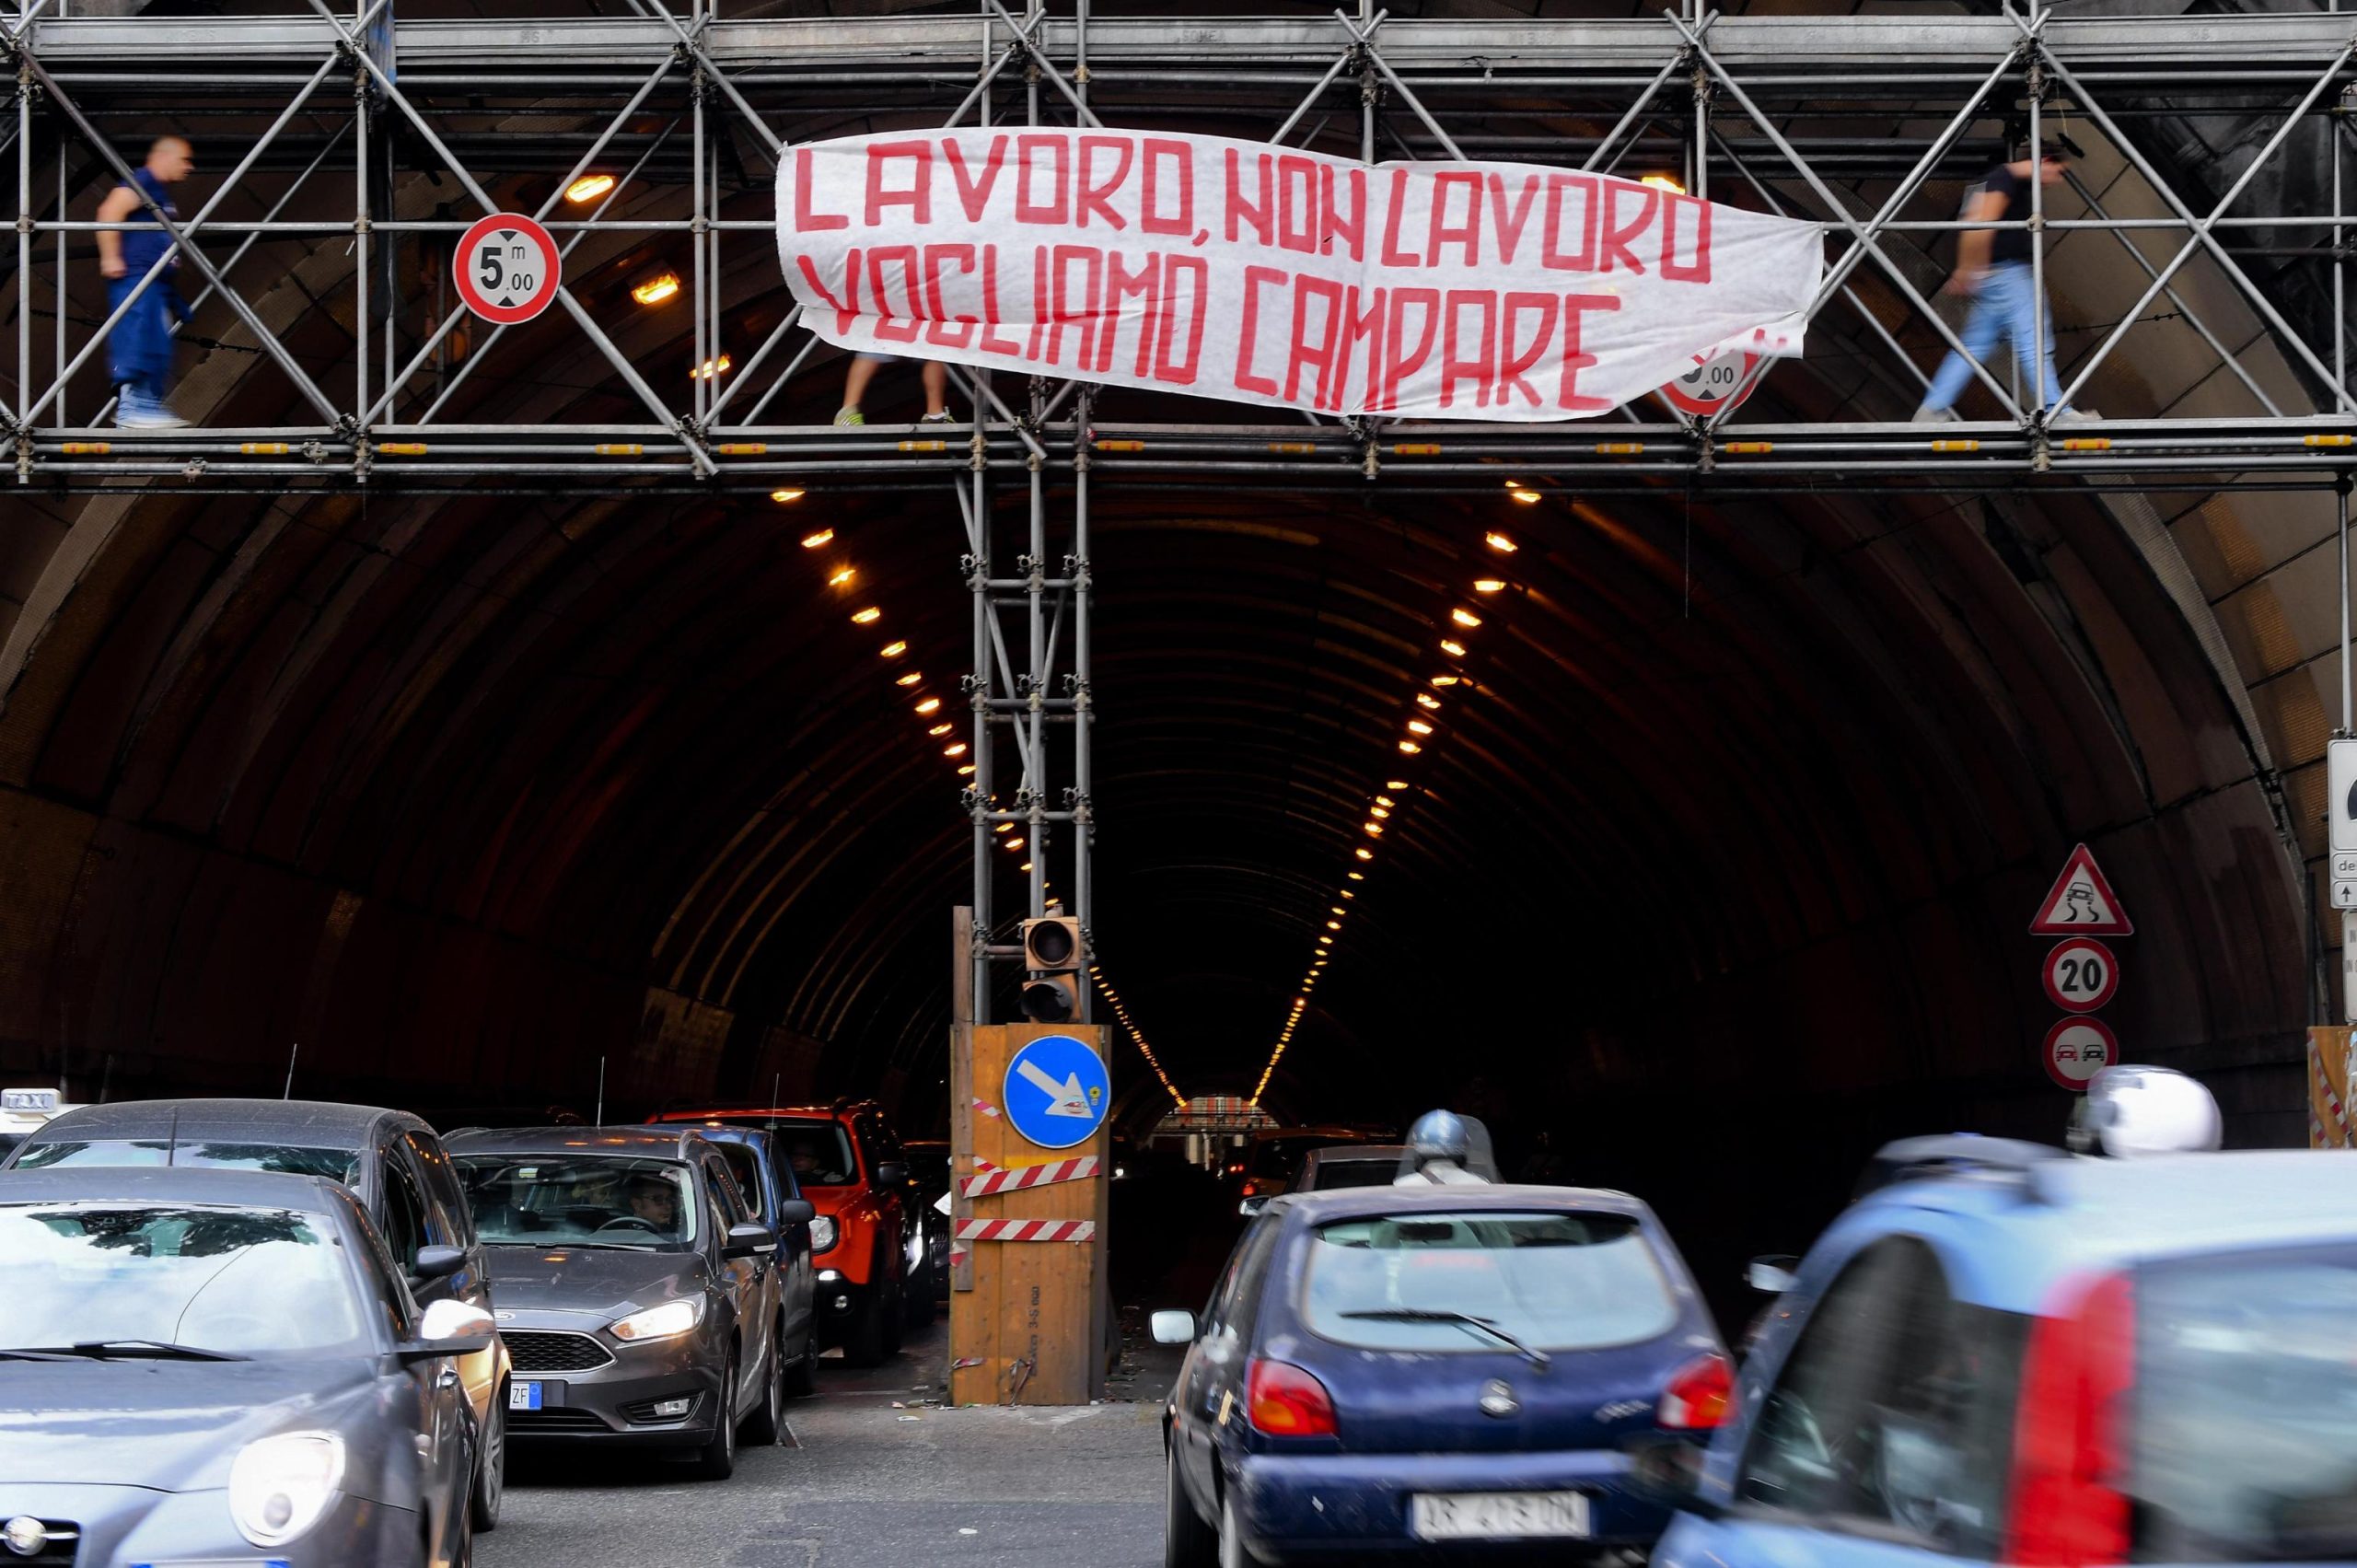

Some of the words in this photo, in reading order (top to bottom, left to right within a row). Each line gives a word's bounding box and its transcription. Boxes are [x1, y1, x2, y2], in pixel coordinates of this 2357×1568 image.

[795, 134, 1209, 246] LAVORO,
[1225, 147, 1367, 262] NON
[1381, 168, 1712, 284] LAVORO
[795, 243, 1209, 386] VOGLIAMO
[1233, 265, 1621, 412] CAMPARE
[2061, 958, 2102, 992] 20
[6, 1094, 52, 1109] TAXI
[512, 1388, 528, 1404] ZF
